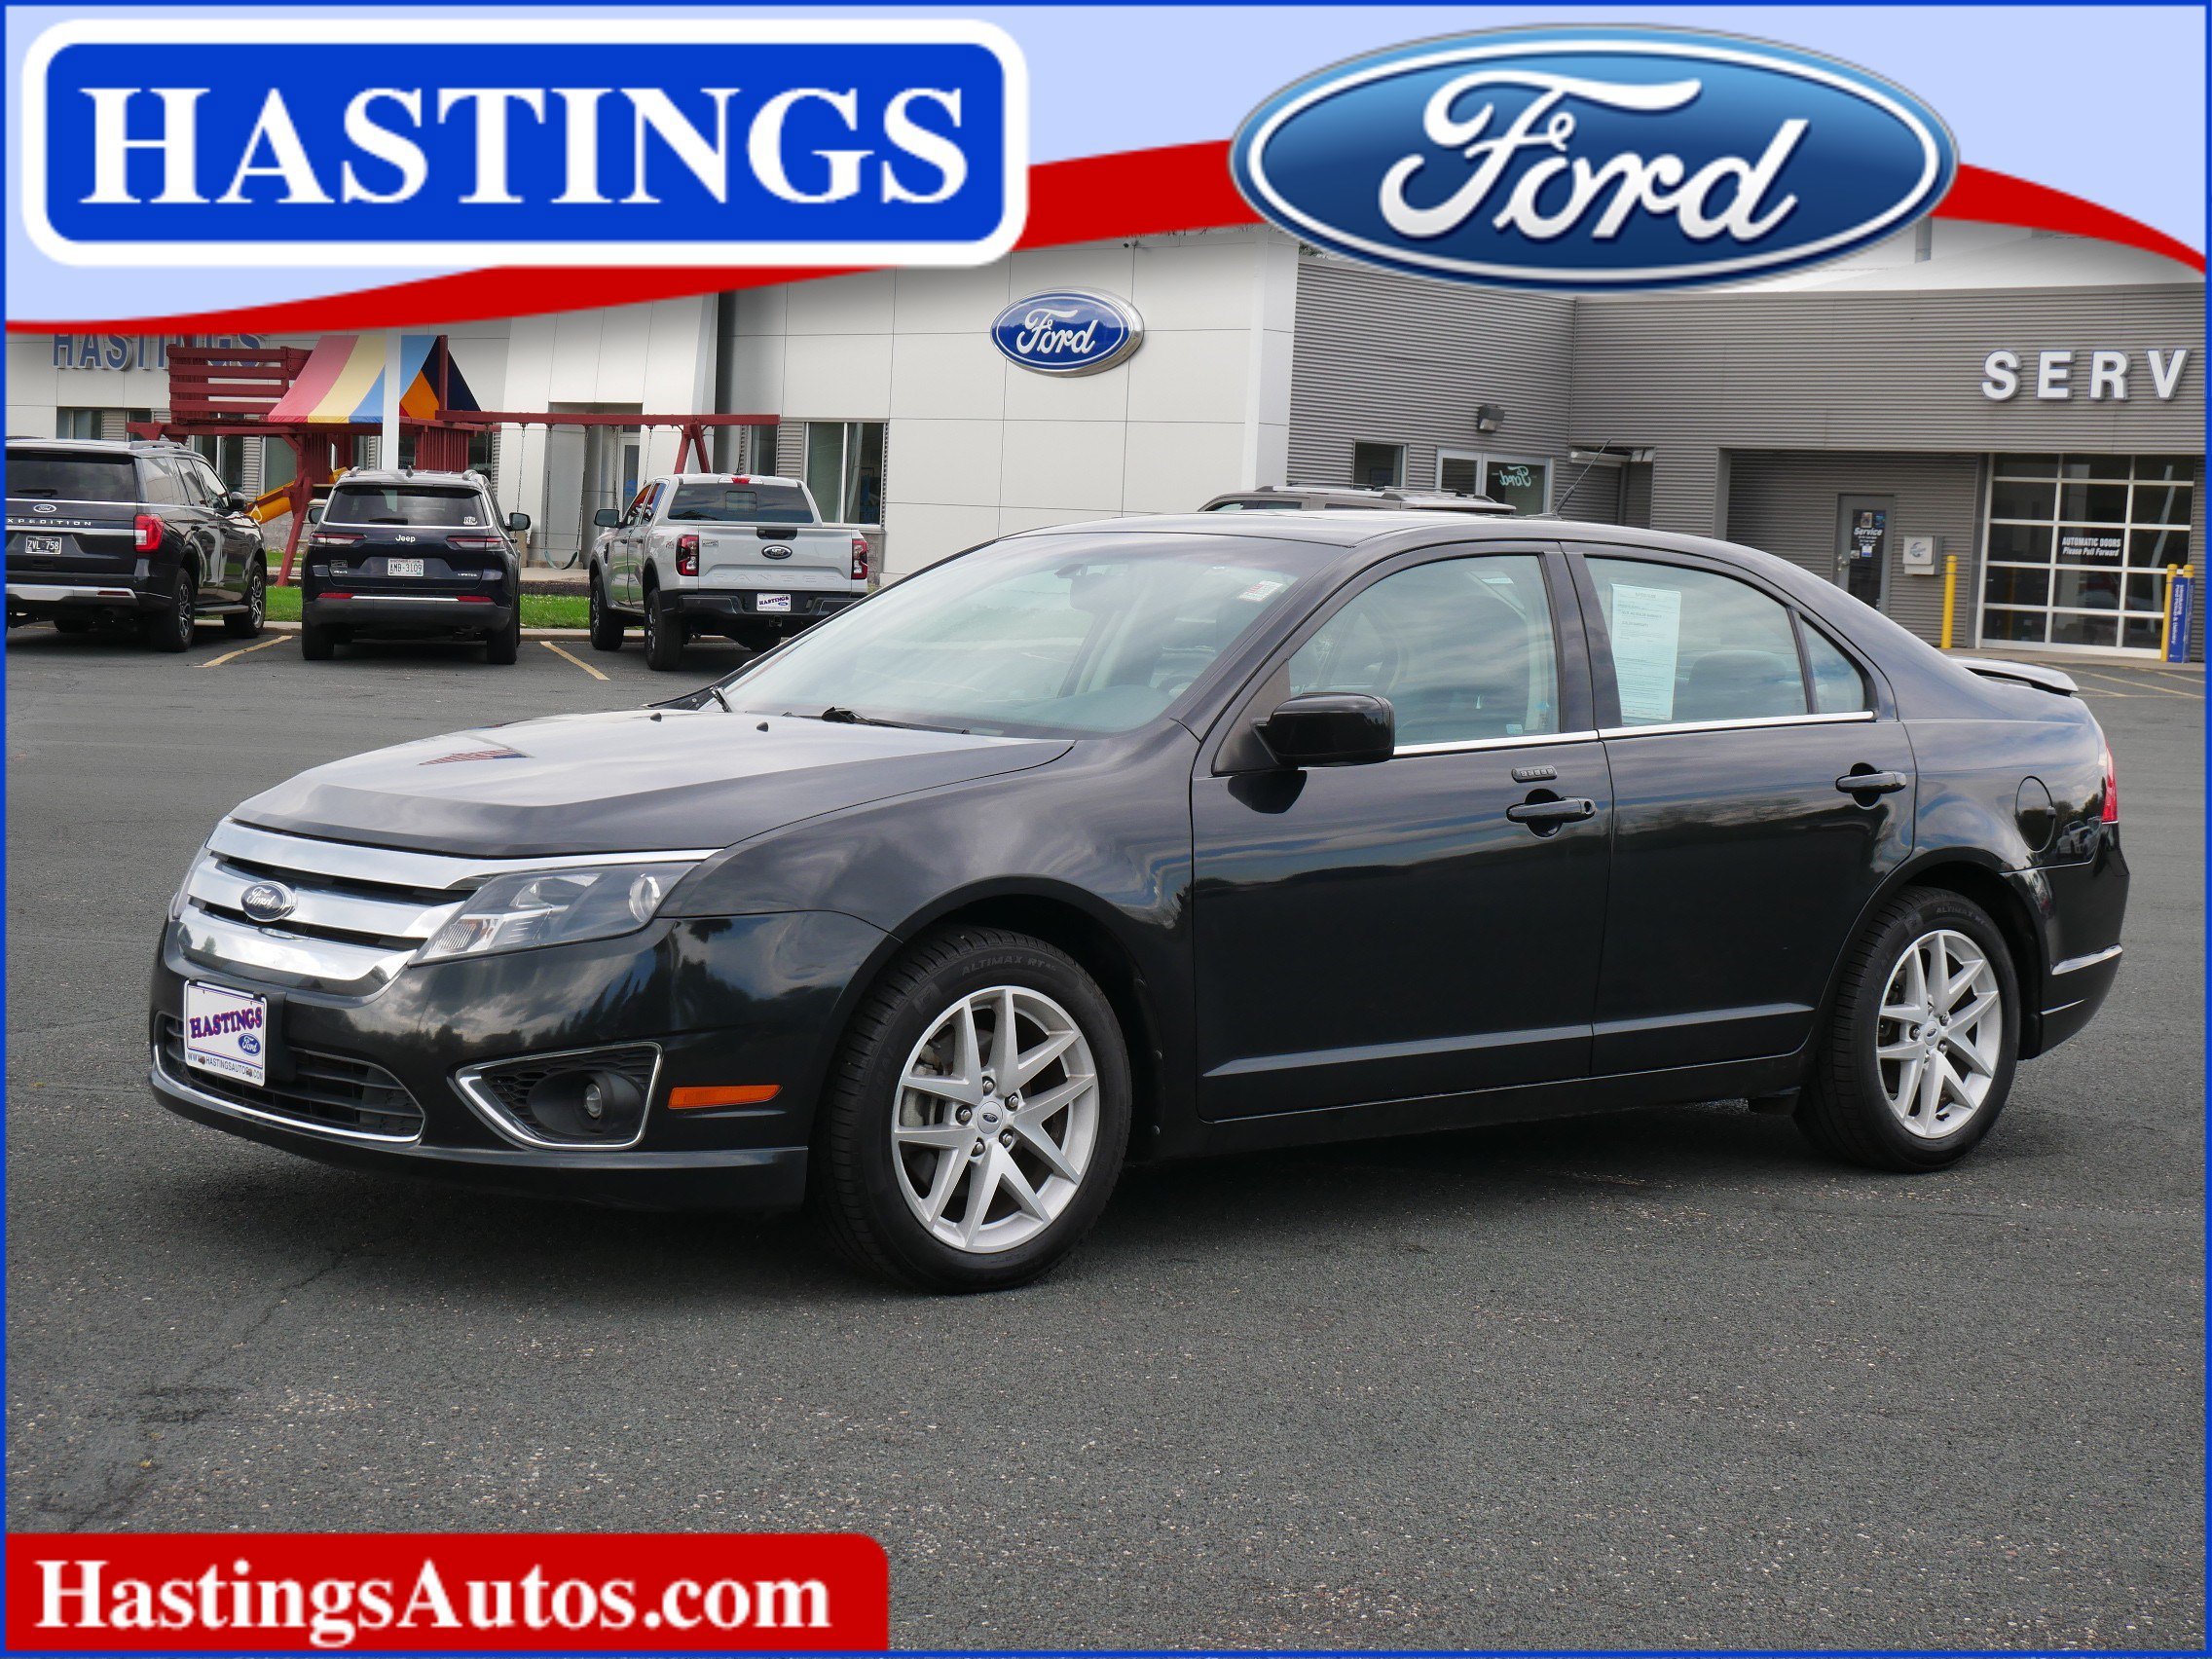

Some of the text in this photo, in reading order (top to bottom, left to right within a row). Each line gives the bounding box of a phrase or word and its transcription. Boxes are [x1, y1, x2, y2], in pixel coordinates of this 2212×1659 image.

[1015, 308, 1099, 354] Ford
[395, 535, 416, 543] Jeep
[1854, 527, 1883, 536] Service
[2062, 536, 2121, 548] AUTOMATIC DOORS
[2063, 546, 2120, 557] Please Pull Forward
[246, 886, 276, 909] Ford
[962, 955, 1023, 975] ALTIMAX
[189, 1006, 263, 1039] HASTINGS
[241, 1035, 258, 1052] Ford
